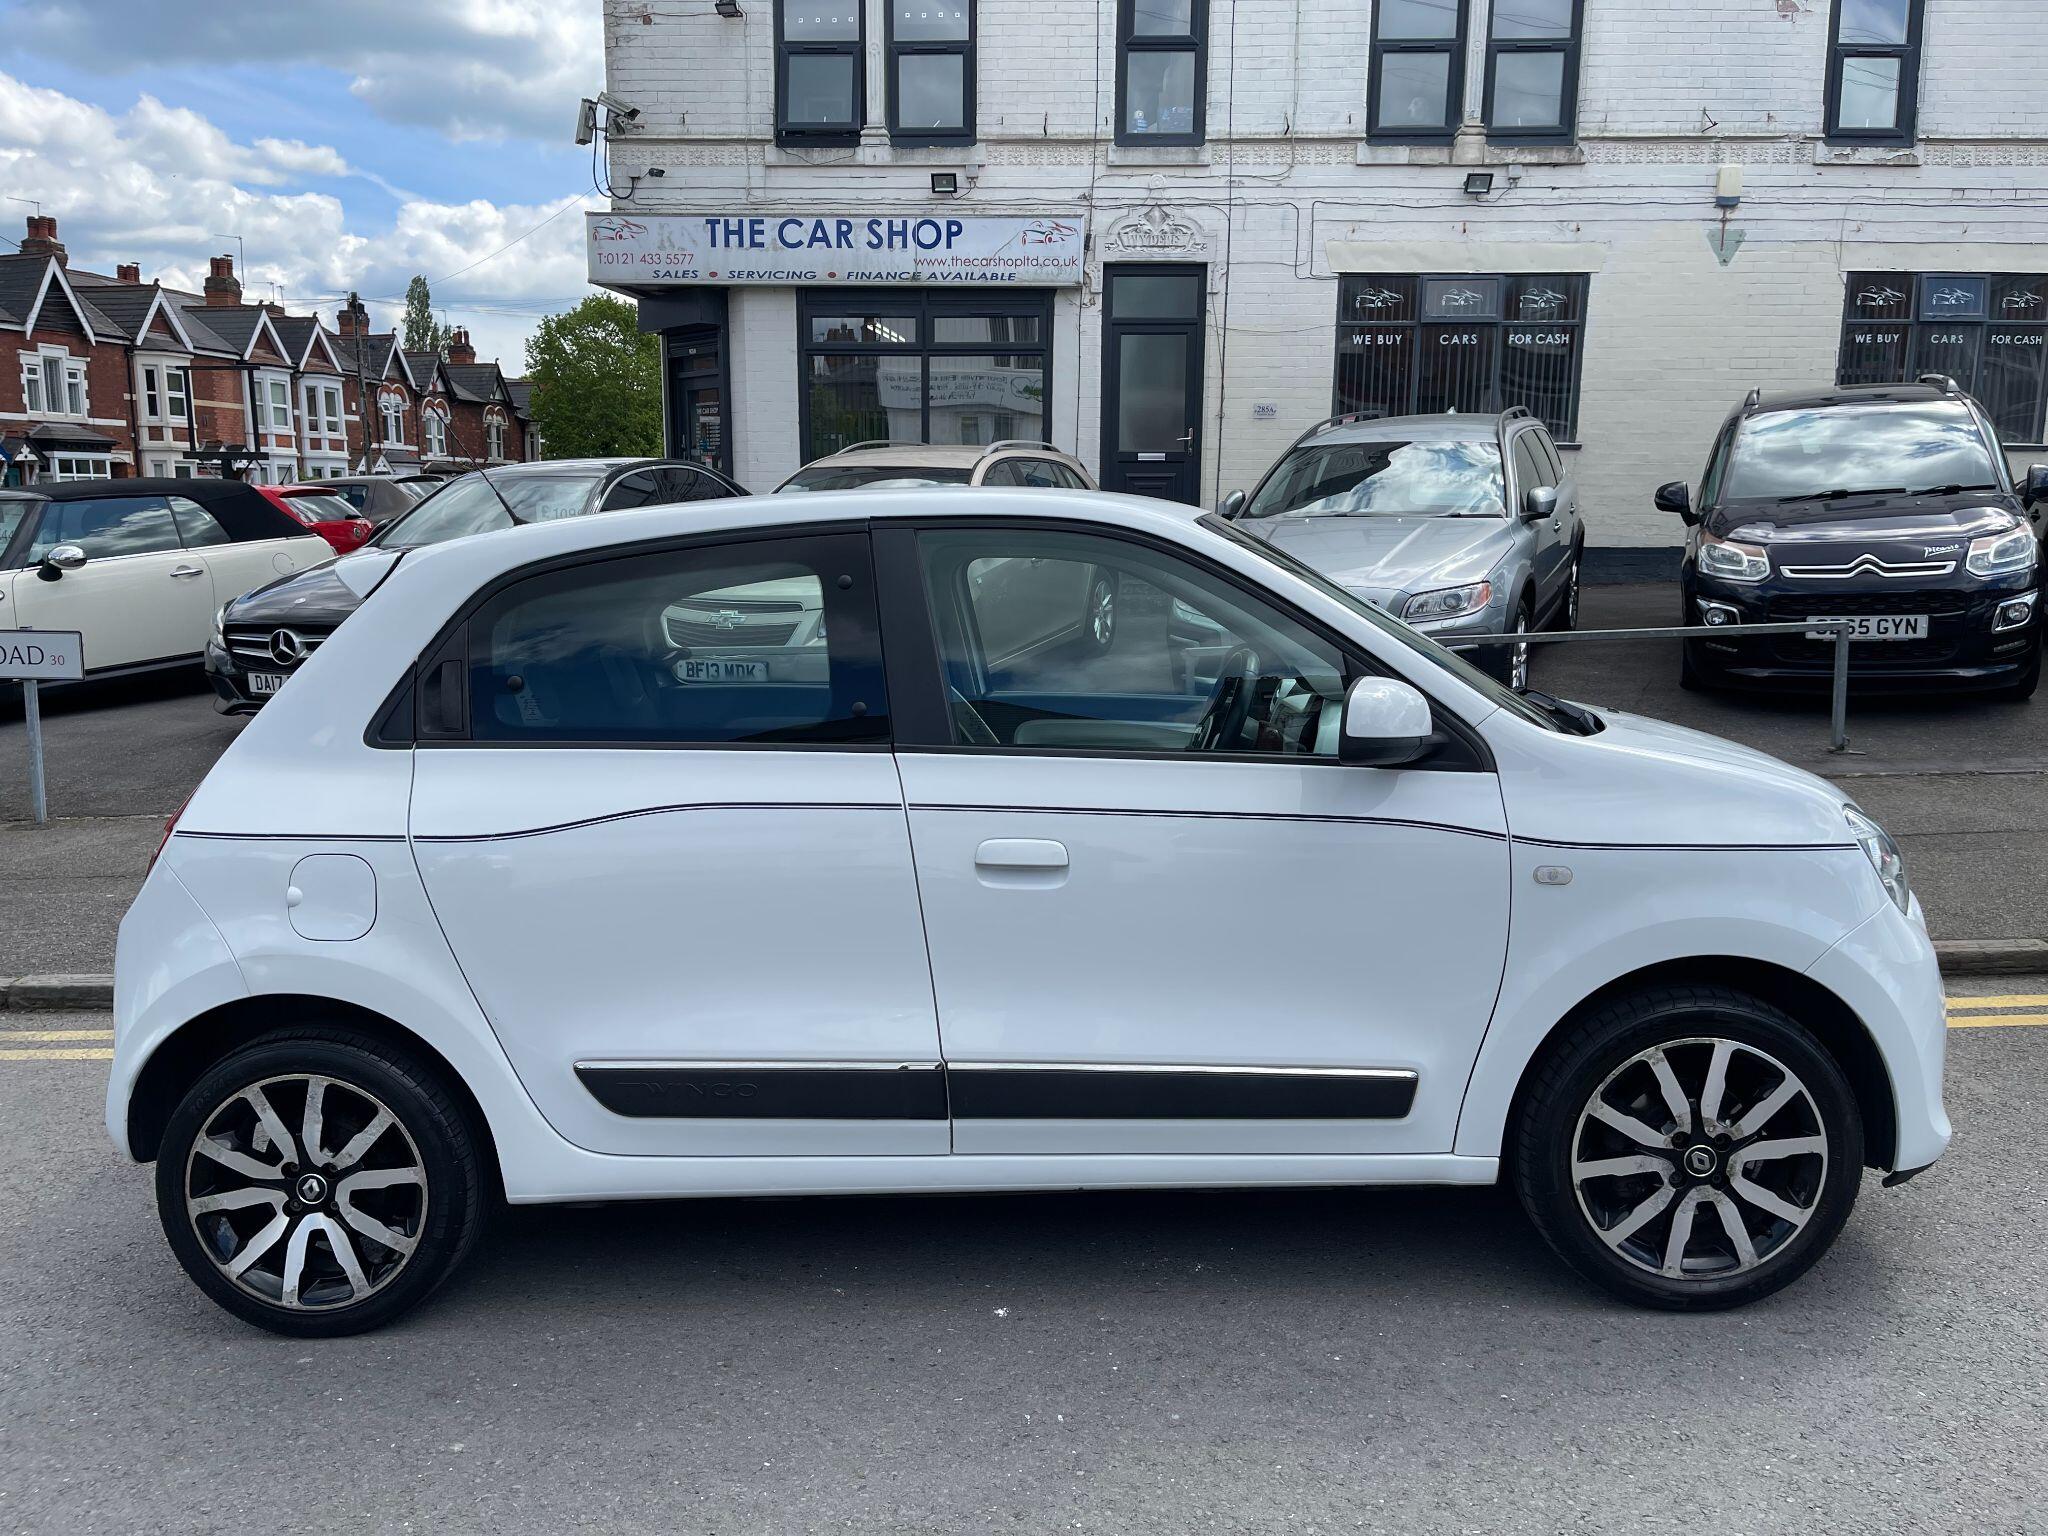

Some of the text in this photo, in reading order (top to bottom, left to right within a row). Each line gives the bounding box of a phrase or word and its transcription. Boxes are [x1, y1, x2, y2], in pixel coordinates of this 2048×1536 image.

[705, 218, 765, 249] THE
[777, 218, 854, 249] CAR
[866, 218, 963, 250] SHOP
[597, 253, 694, 265] T:0121 433 5577
[913, 256, 1079, 269] www.thecarshopltd.co.uk
[652, 269, 1017, 281] SALES SERVICING FINANCE AVAILABLE
[1352, 333, 1569, 345] WE BUY CARS FOR CASH
[1855, 333, 2042, 344] WE BUY CARS FOR CASH
[1815, 618, 1918, 635] 65 GYN
[50, 654, 65, 666] 30
[686, 661, 720, 679] BF13
